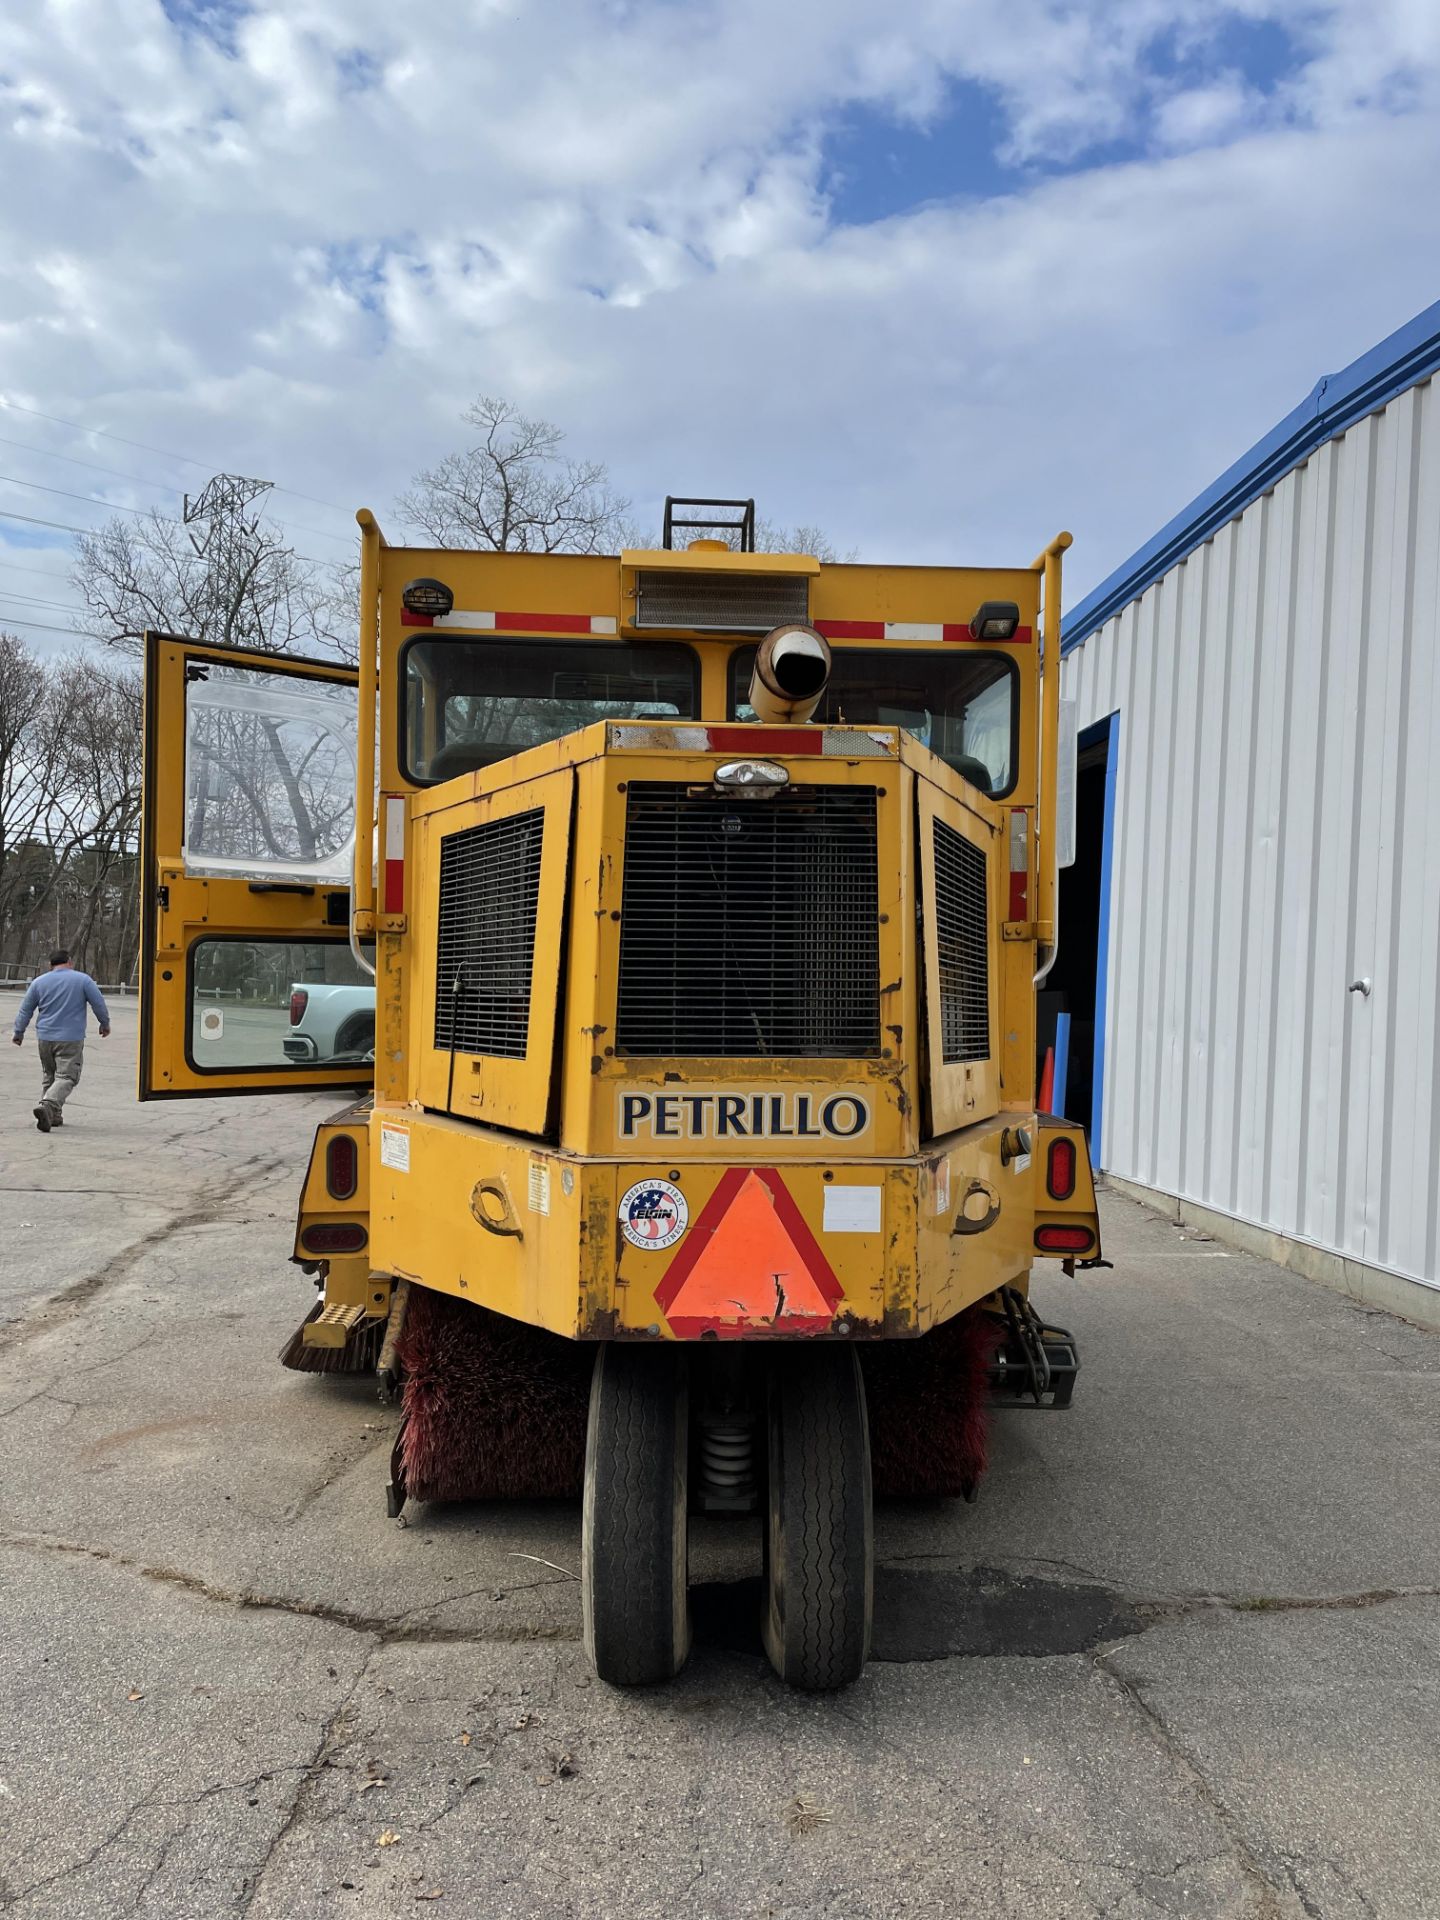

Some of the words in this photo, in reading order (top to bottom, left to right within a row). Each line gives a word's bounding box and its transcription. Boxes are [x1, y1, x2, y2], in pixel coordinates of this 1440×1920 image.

[620, 1094, 869, 1138] PETRILLO
[623, 1182, 662, 1208] AMERICA'S
[666, 1186, 685, 1207] FIRST
[636, 1209, 673, 1220] ELGIN
[623, 1221, 658, 1248] MERICA'S
[662, 1218, 685, 1245] FINEST
